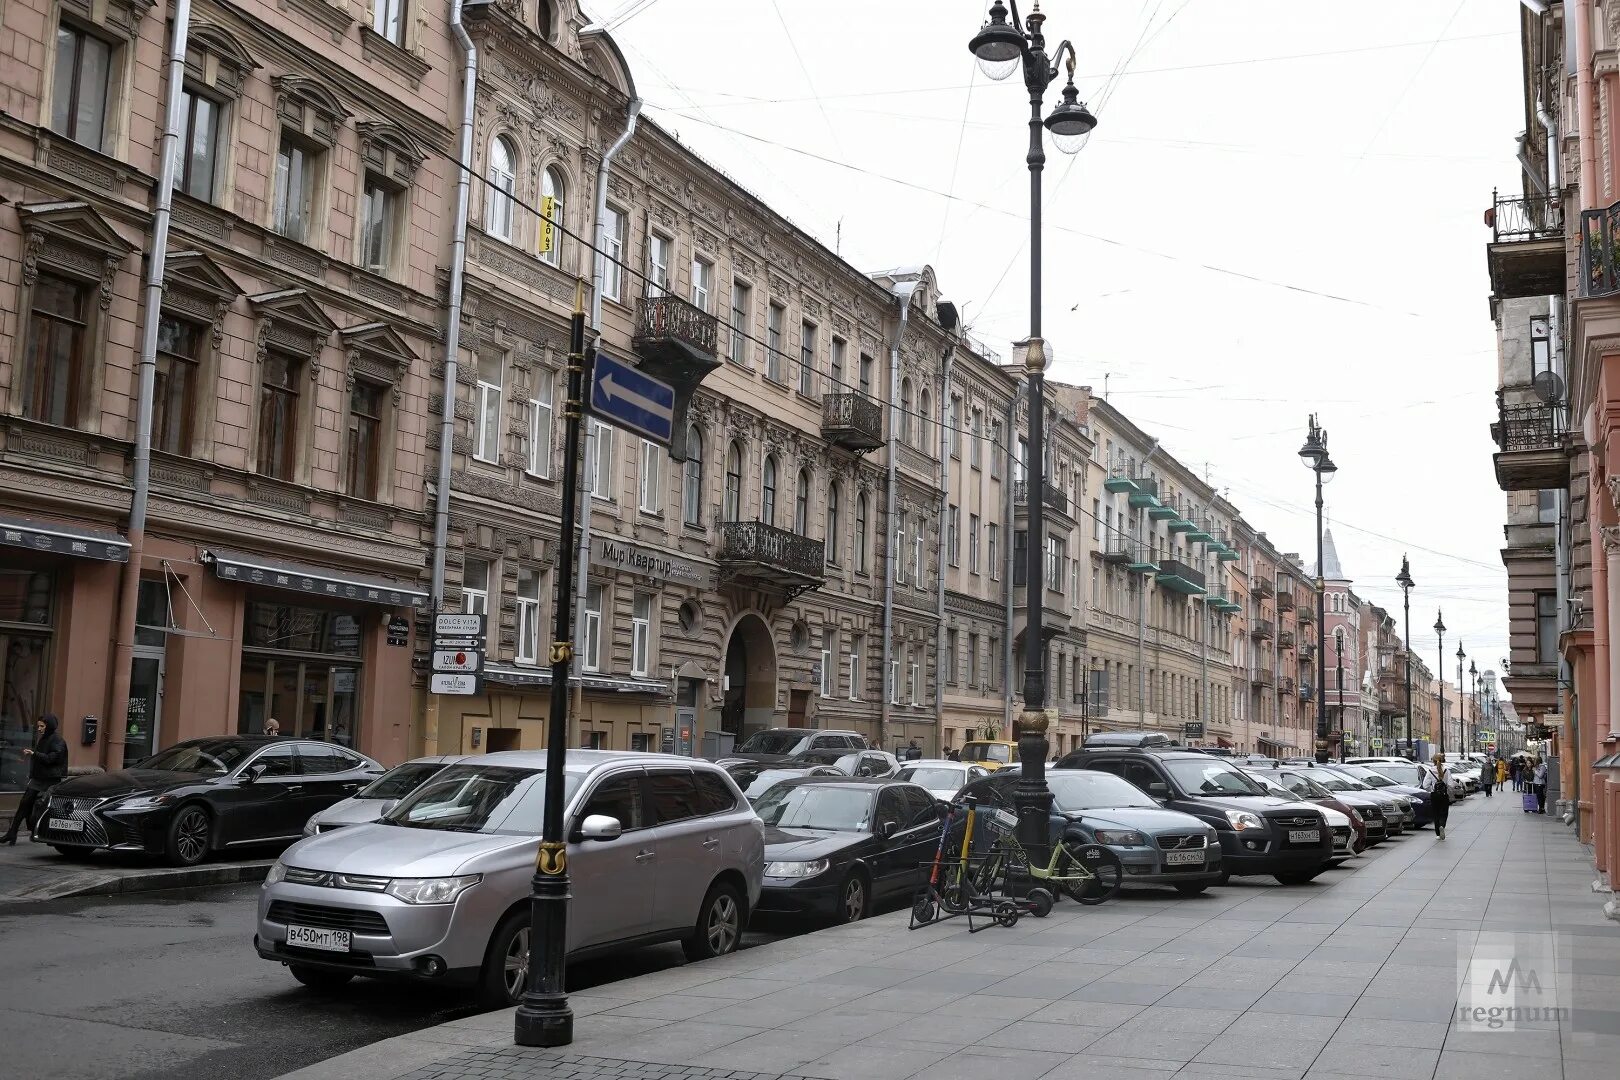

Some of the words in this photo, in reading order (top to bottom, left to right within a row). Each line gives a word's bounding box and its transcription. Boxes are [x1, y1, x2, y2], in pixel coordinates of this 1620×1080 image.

[601, 542, 624, 566] Мир
[627, 548, 671, 577] Квартир
[292, 928, 329, 944] В450МТ
[332, 931, 348, 942] 198
